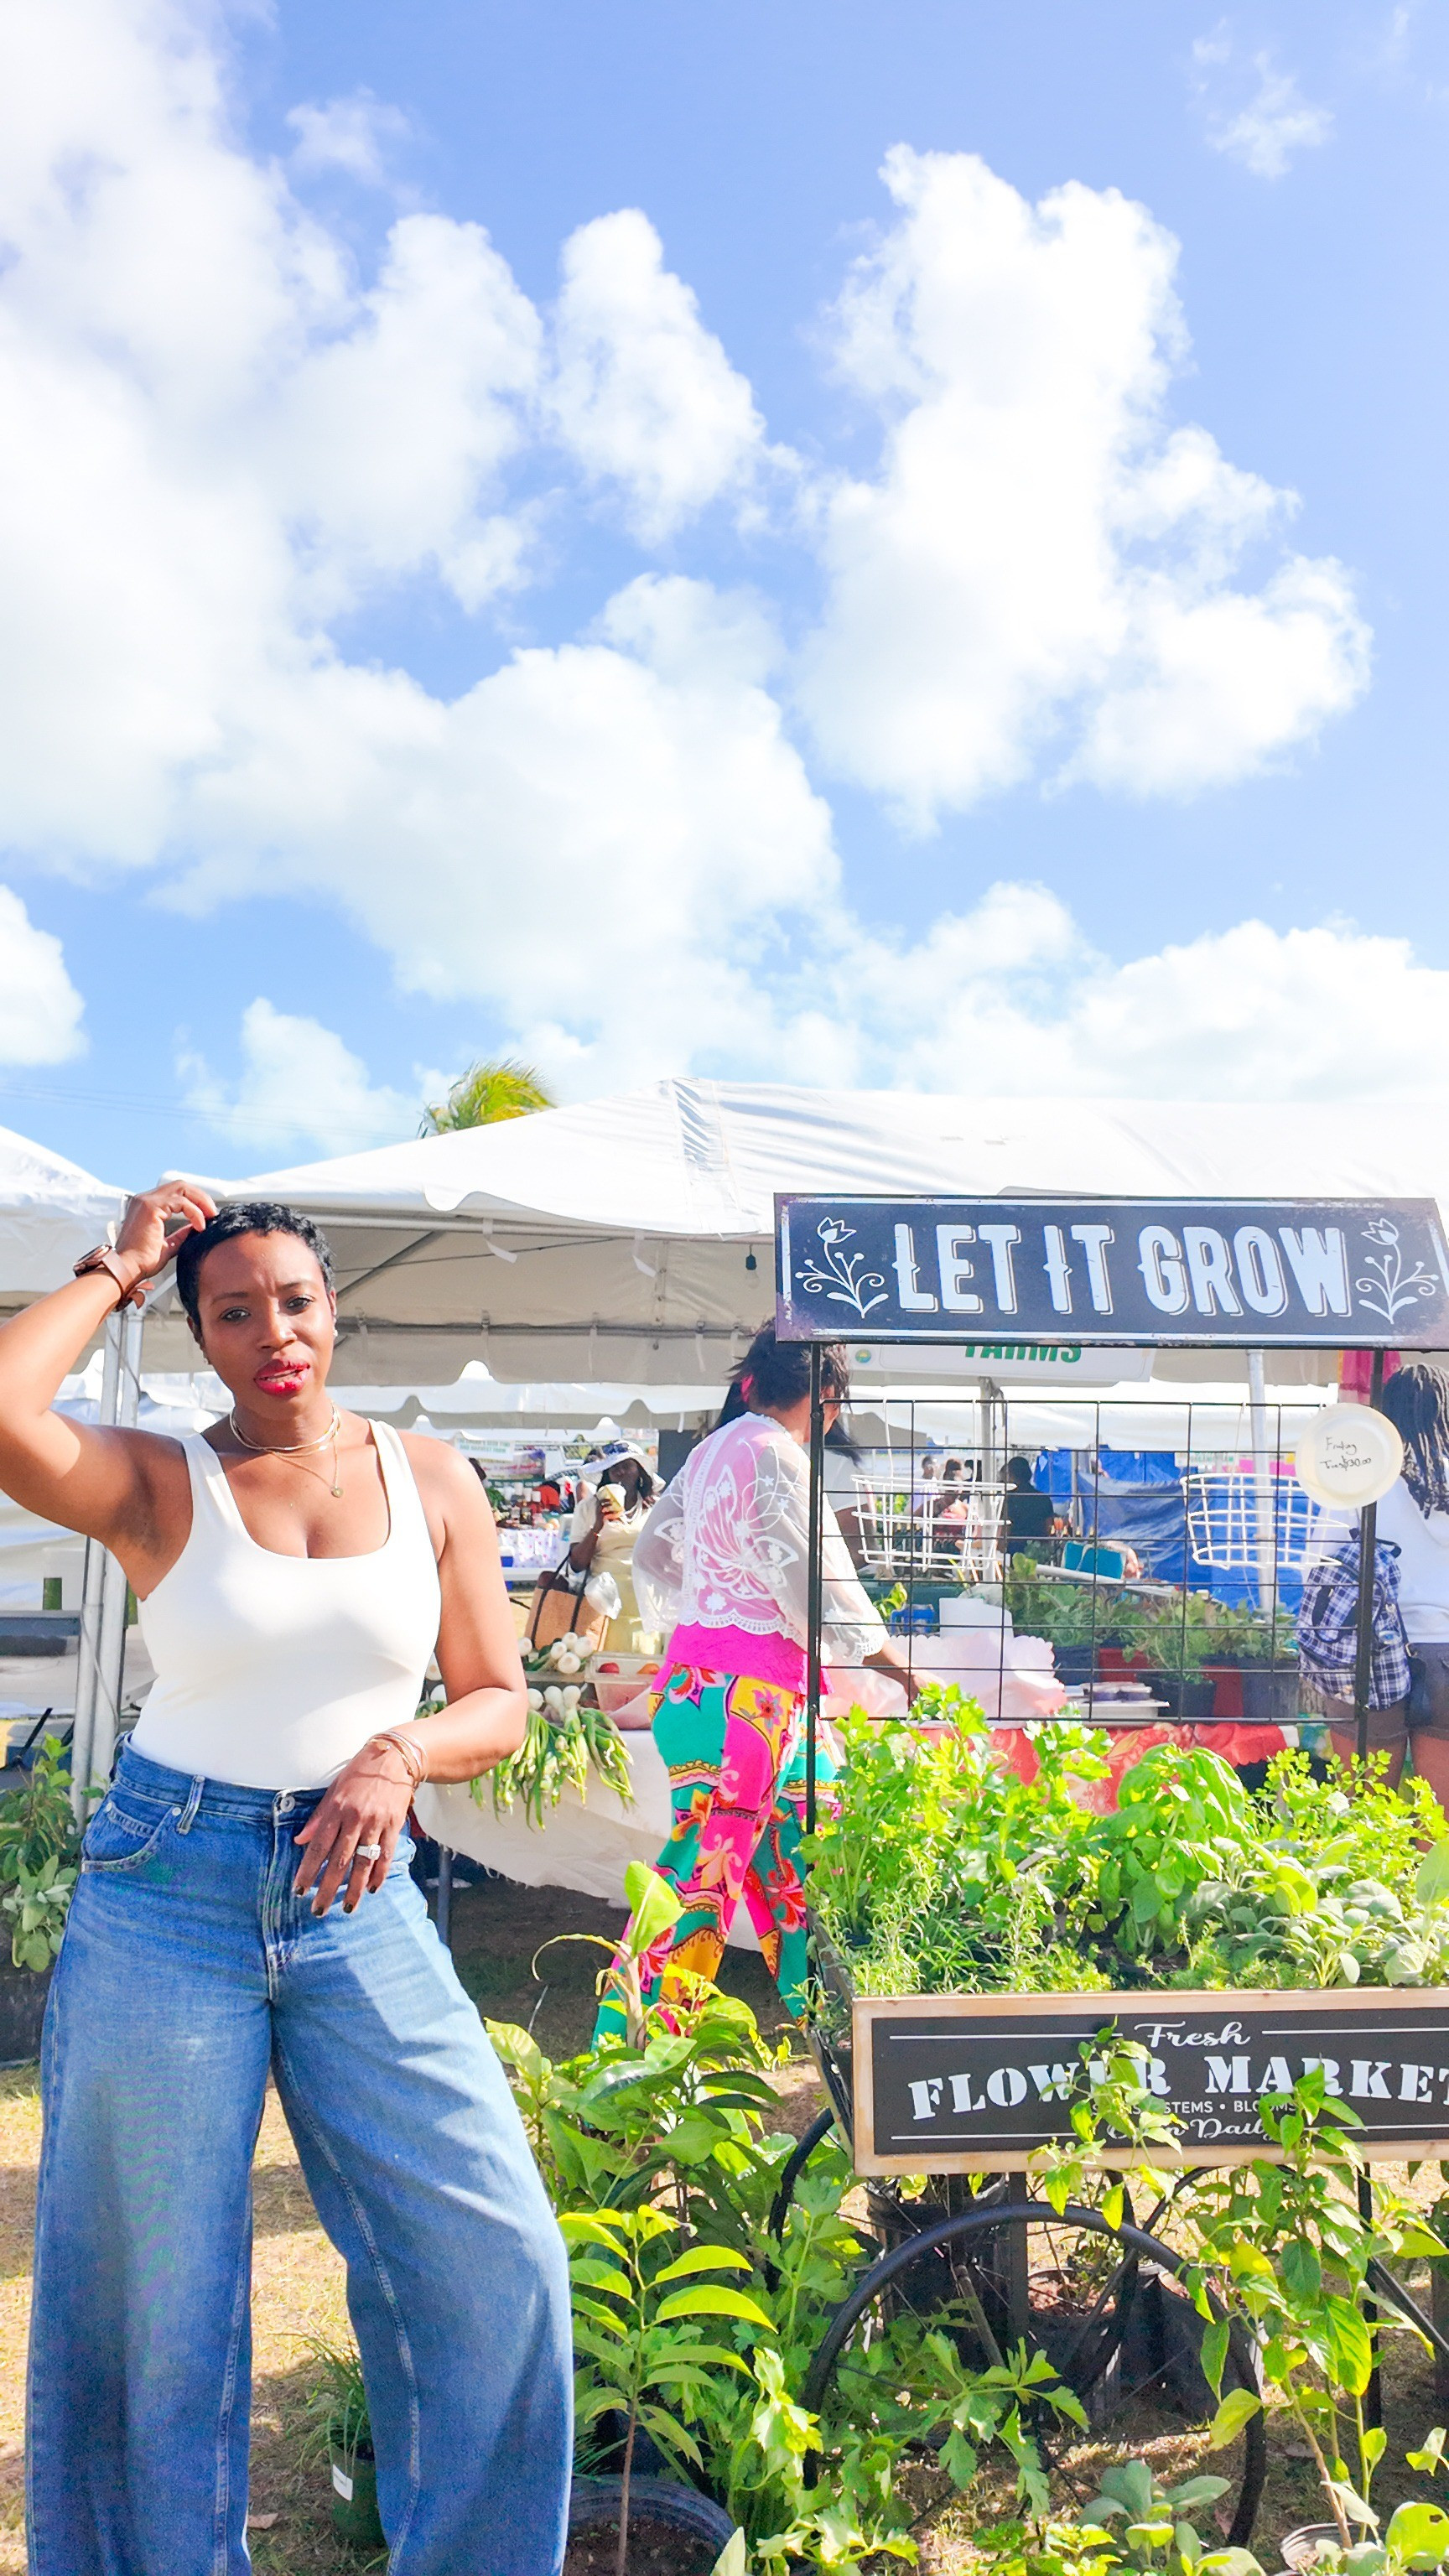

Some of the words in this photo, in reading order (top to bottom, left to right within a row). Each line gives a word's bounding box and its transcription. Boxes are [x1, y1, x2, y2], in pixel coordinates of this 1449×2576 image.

[891, 1223, 1021, 1314] LET
[1042, 1223, 1115, 1315] IT
[1136, 1225, 1352, 1317] GROW
[1134, 2021, 1251, 2048] Fresh
[1164, 2101, 1213, 2114] STEMS
